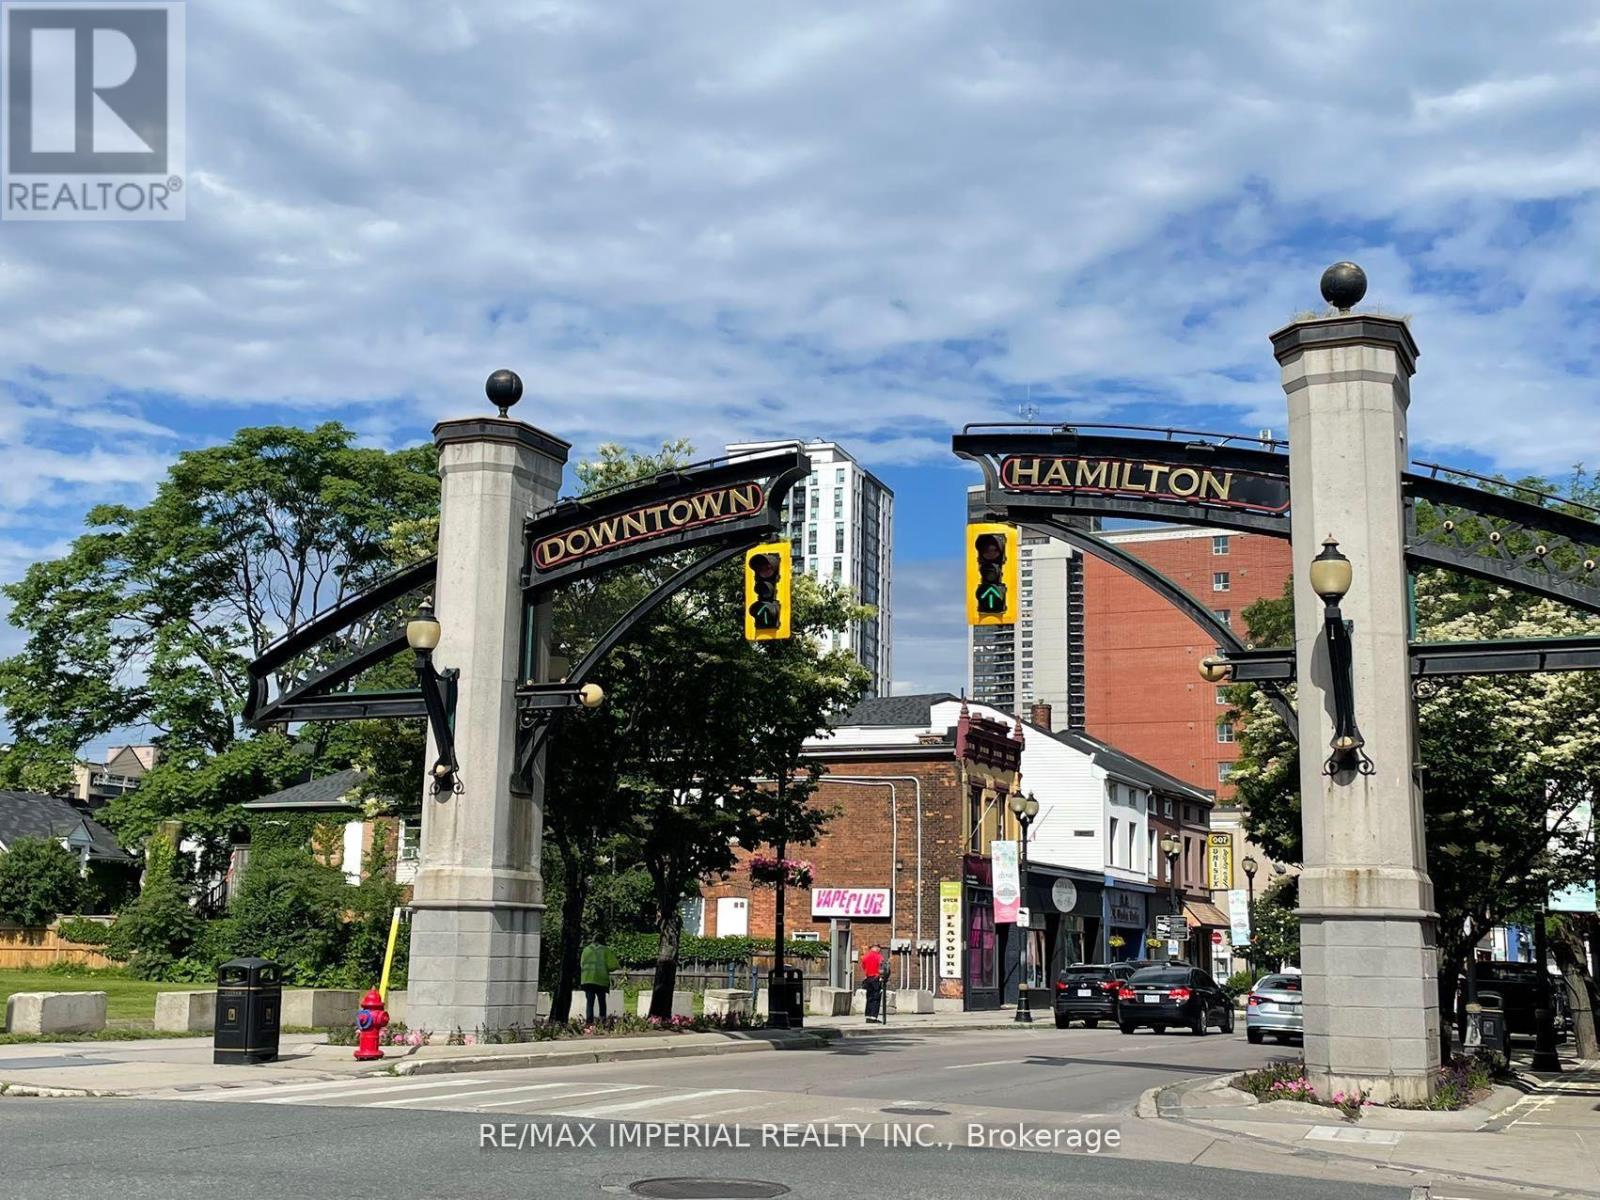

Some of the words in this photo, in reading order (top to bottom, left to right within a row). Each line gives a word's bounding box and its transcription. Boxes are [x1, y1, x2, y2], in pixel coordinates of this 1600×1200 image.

[1011, 458, 1233, 500] HAMILTON
[541, 485, 755, 564] DOWNTOWN
[946, 915, 955, 975] FLAVOURS
